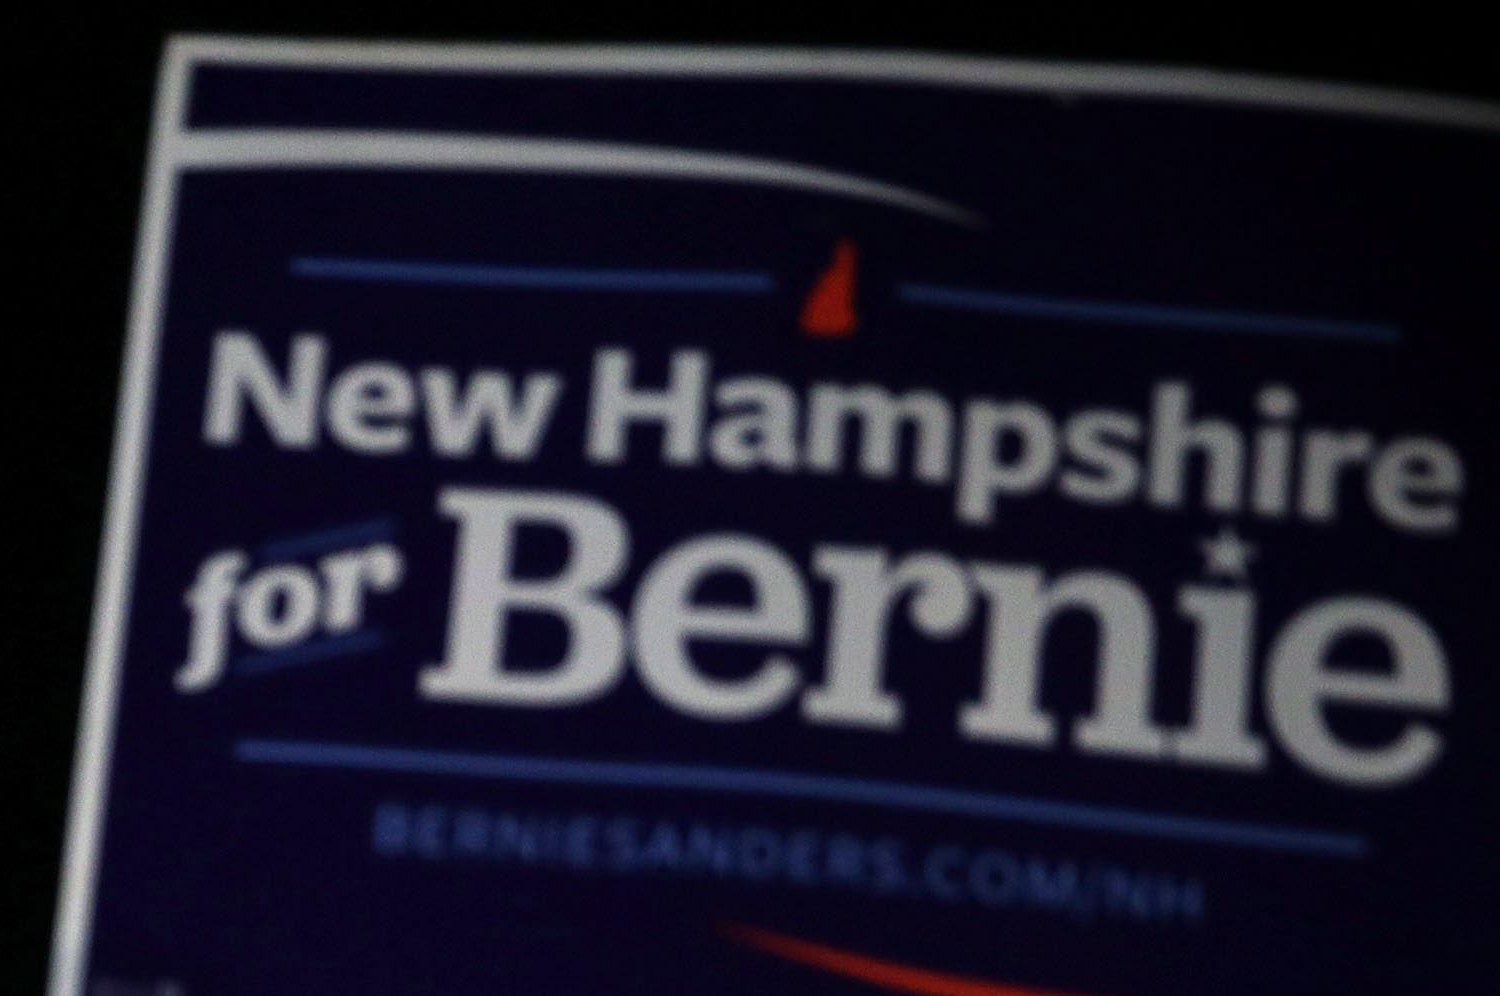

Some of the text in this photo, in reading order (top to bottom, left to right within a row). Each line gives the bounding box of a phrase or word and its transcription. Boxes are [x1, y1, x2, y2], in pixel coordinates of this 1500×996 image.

[203, 327, 1469, 539] New Hampshire
[172, 481, 1456, 790] for Bernie
[371, 800, 1207, 926] BERNIESANDERS.COM/NH
